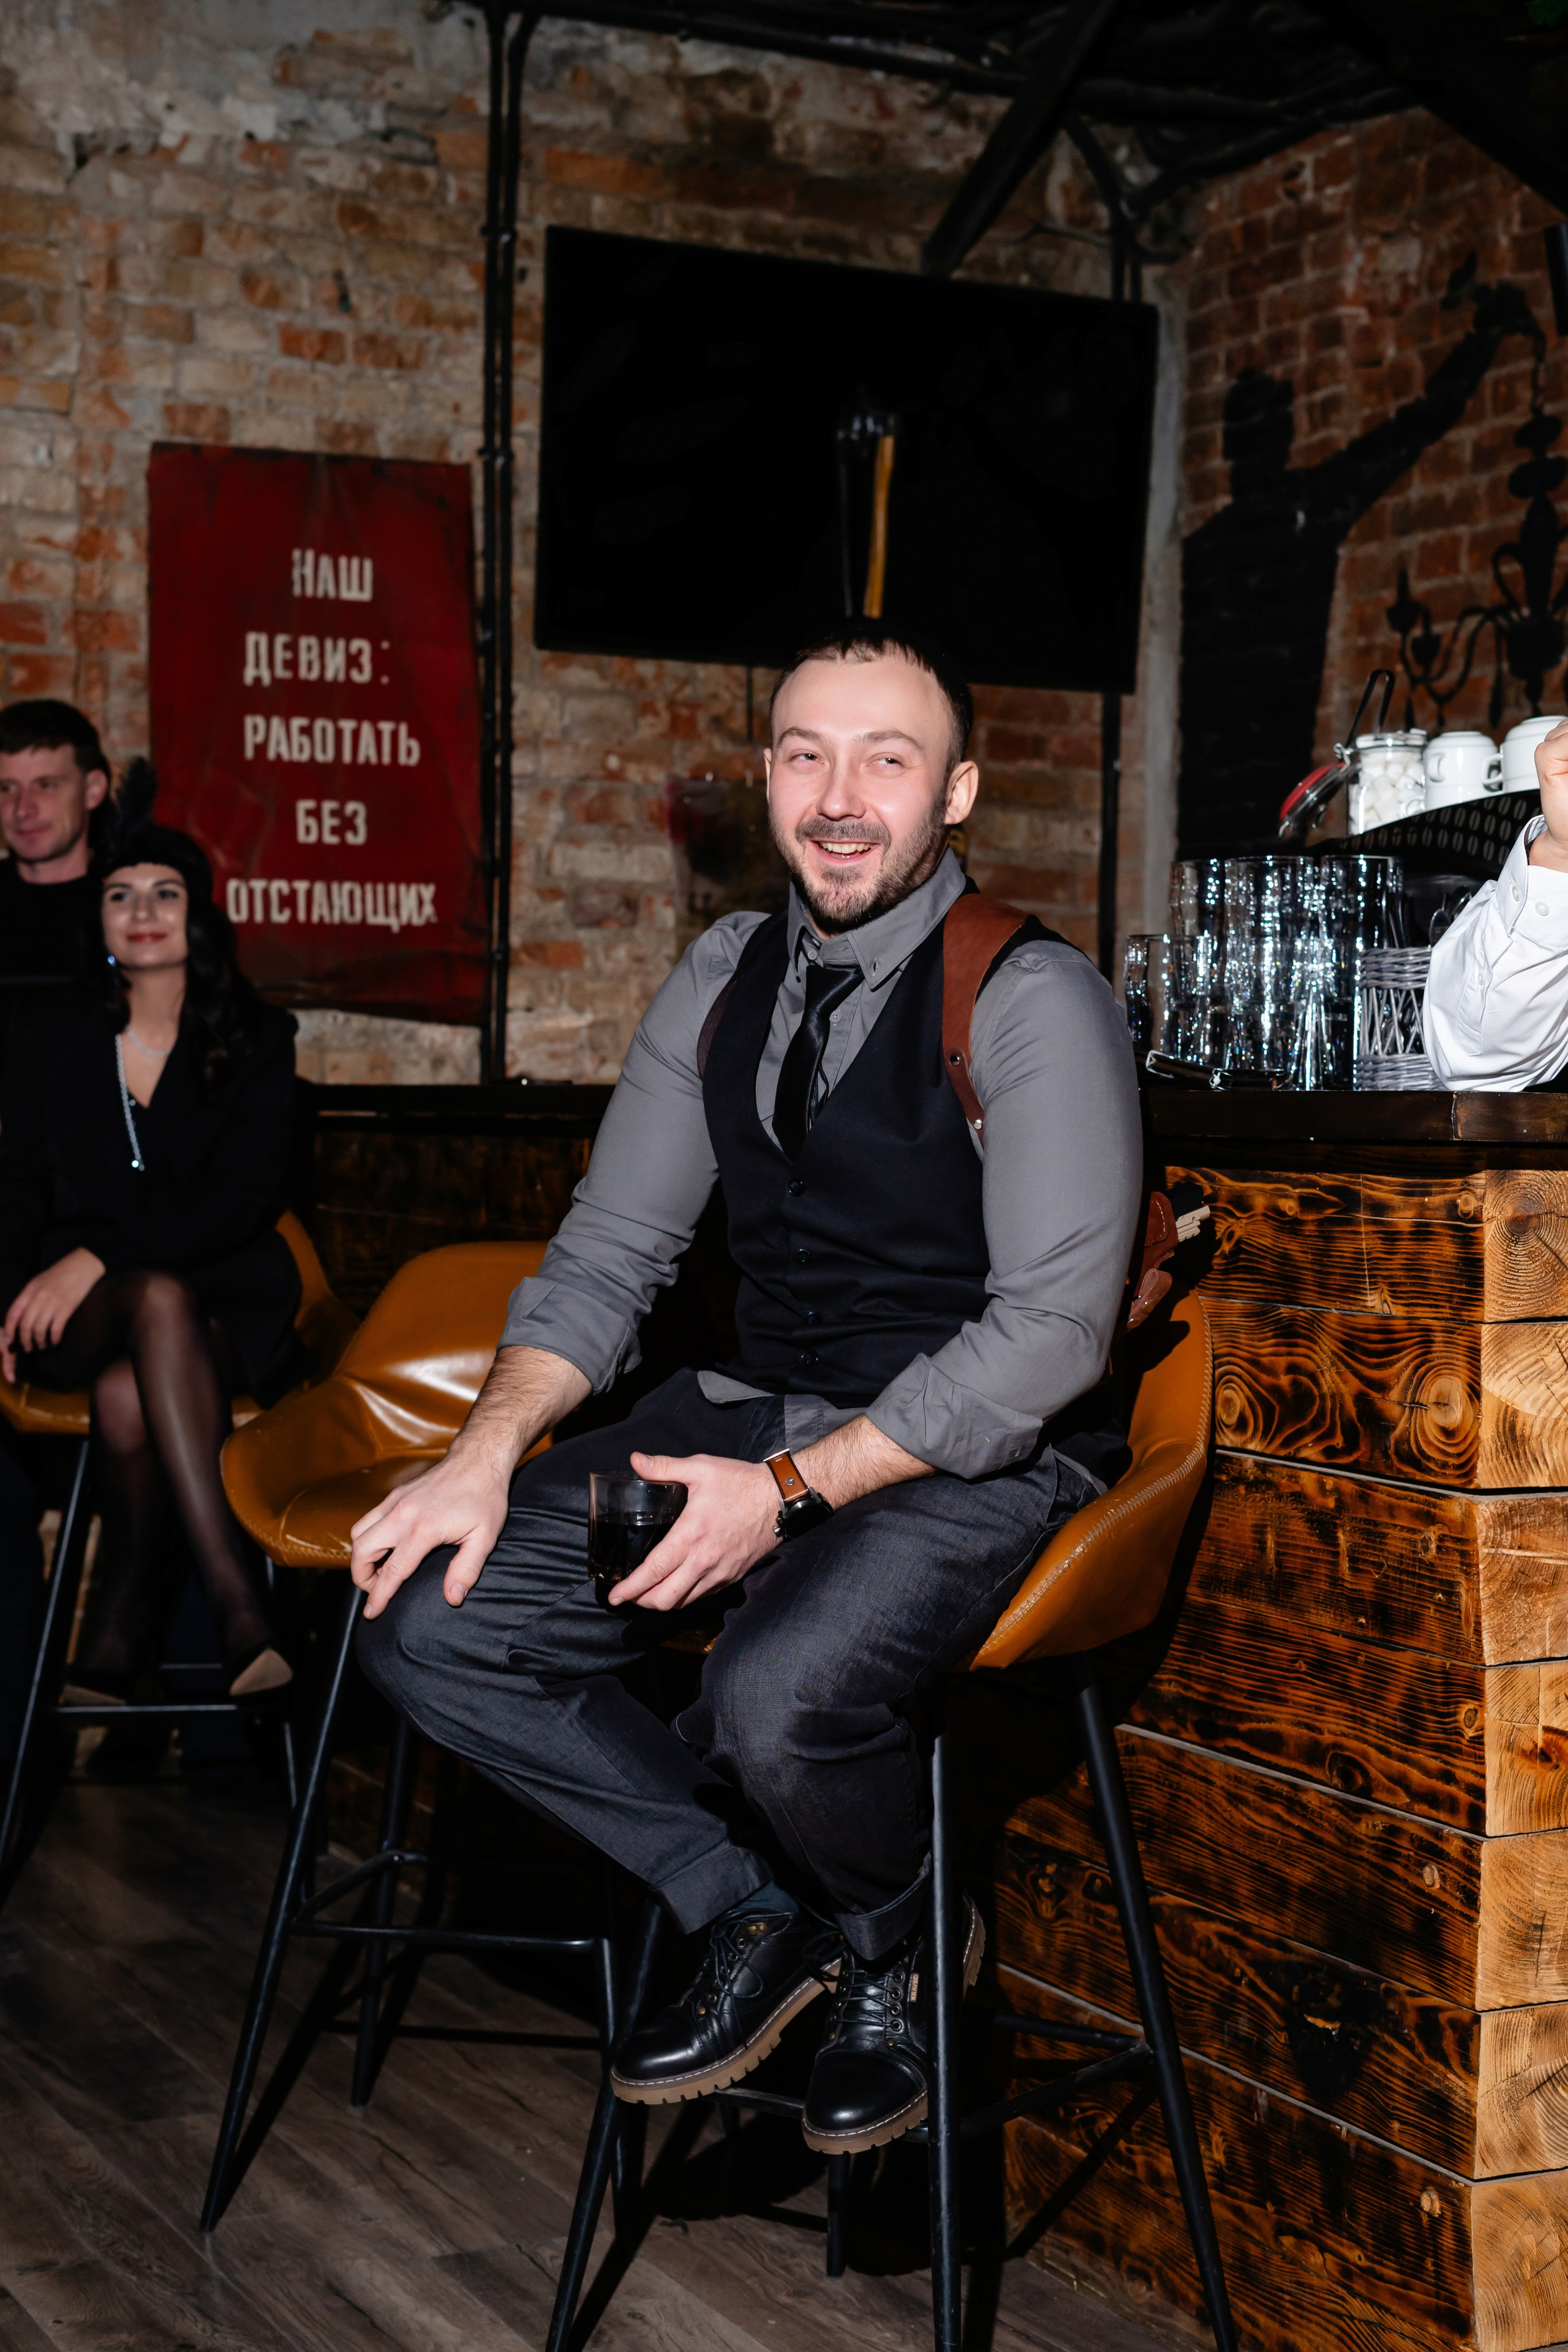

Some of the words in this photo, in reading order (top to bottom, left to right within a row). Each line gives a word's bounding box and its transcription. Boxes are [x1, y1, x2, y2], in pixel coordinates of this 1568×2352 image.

[292, 548, 373, 602] НАШ
[243, 714, 421, 766] РАБОТАТЬ
[295, 799, 367, 845] БЕЗ
[225, 877, 437, 933] ОТСТАЮЩИХ
